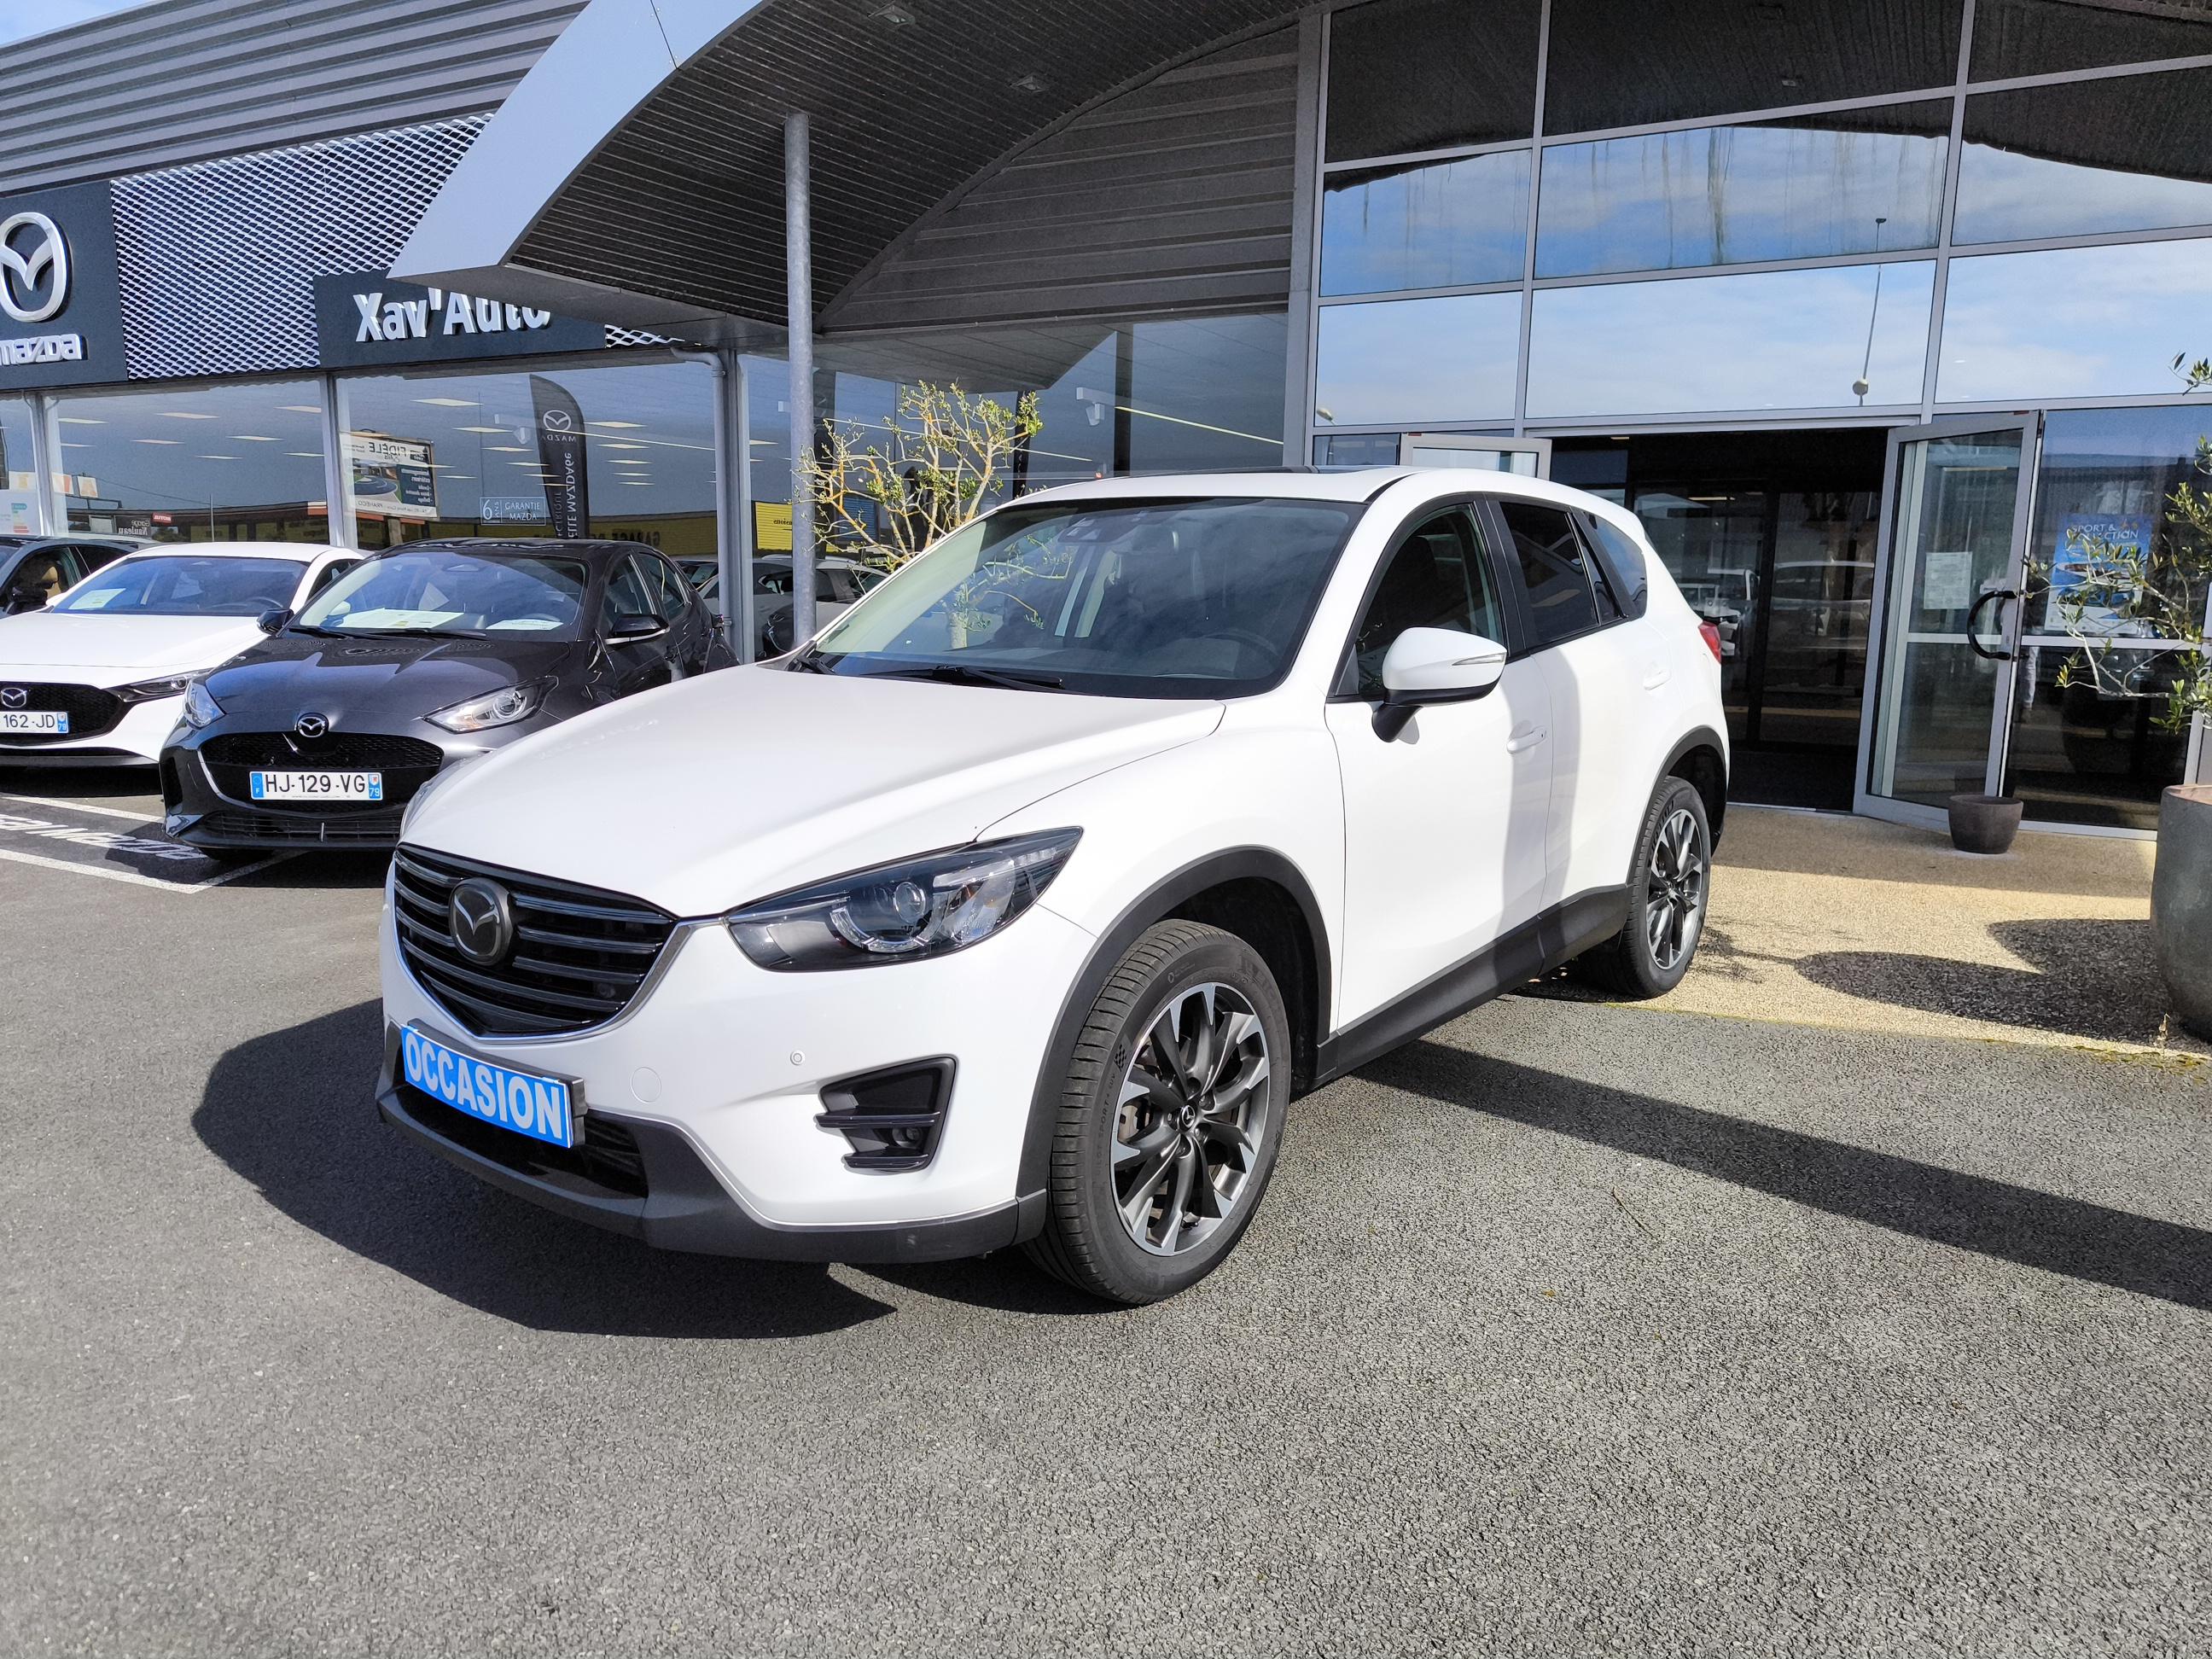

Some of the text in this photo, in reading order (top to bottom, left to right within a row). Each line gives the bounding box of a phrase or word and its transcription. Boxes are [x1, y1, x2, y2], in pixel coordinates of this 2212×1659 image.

[482, 499, 493, 521] 6
[504, 502, 540, 510] GARANTIE
[509, 512, 538, 521] MAZDA
[2071, 523, 2106, 533] SPORT
[369, 787, 381, 797] 79
[405, 1032, 562, 1140] OCCASION
